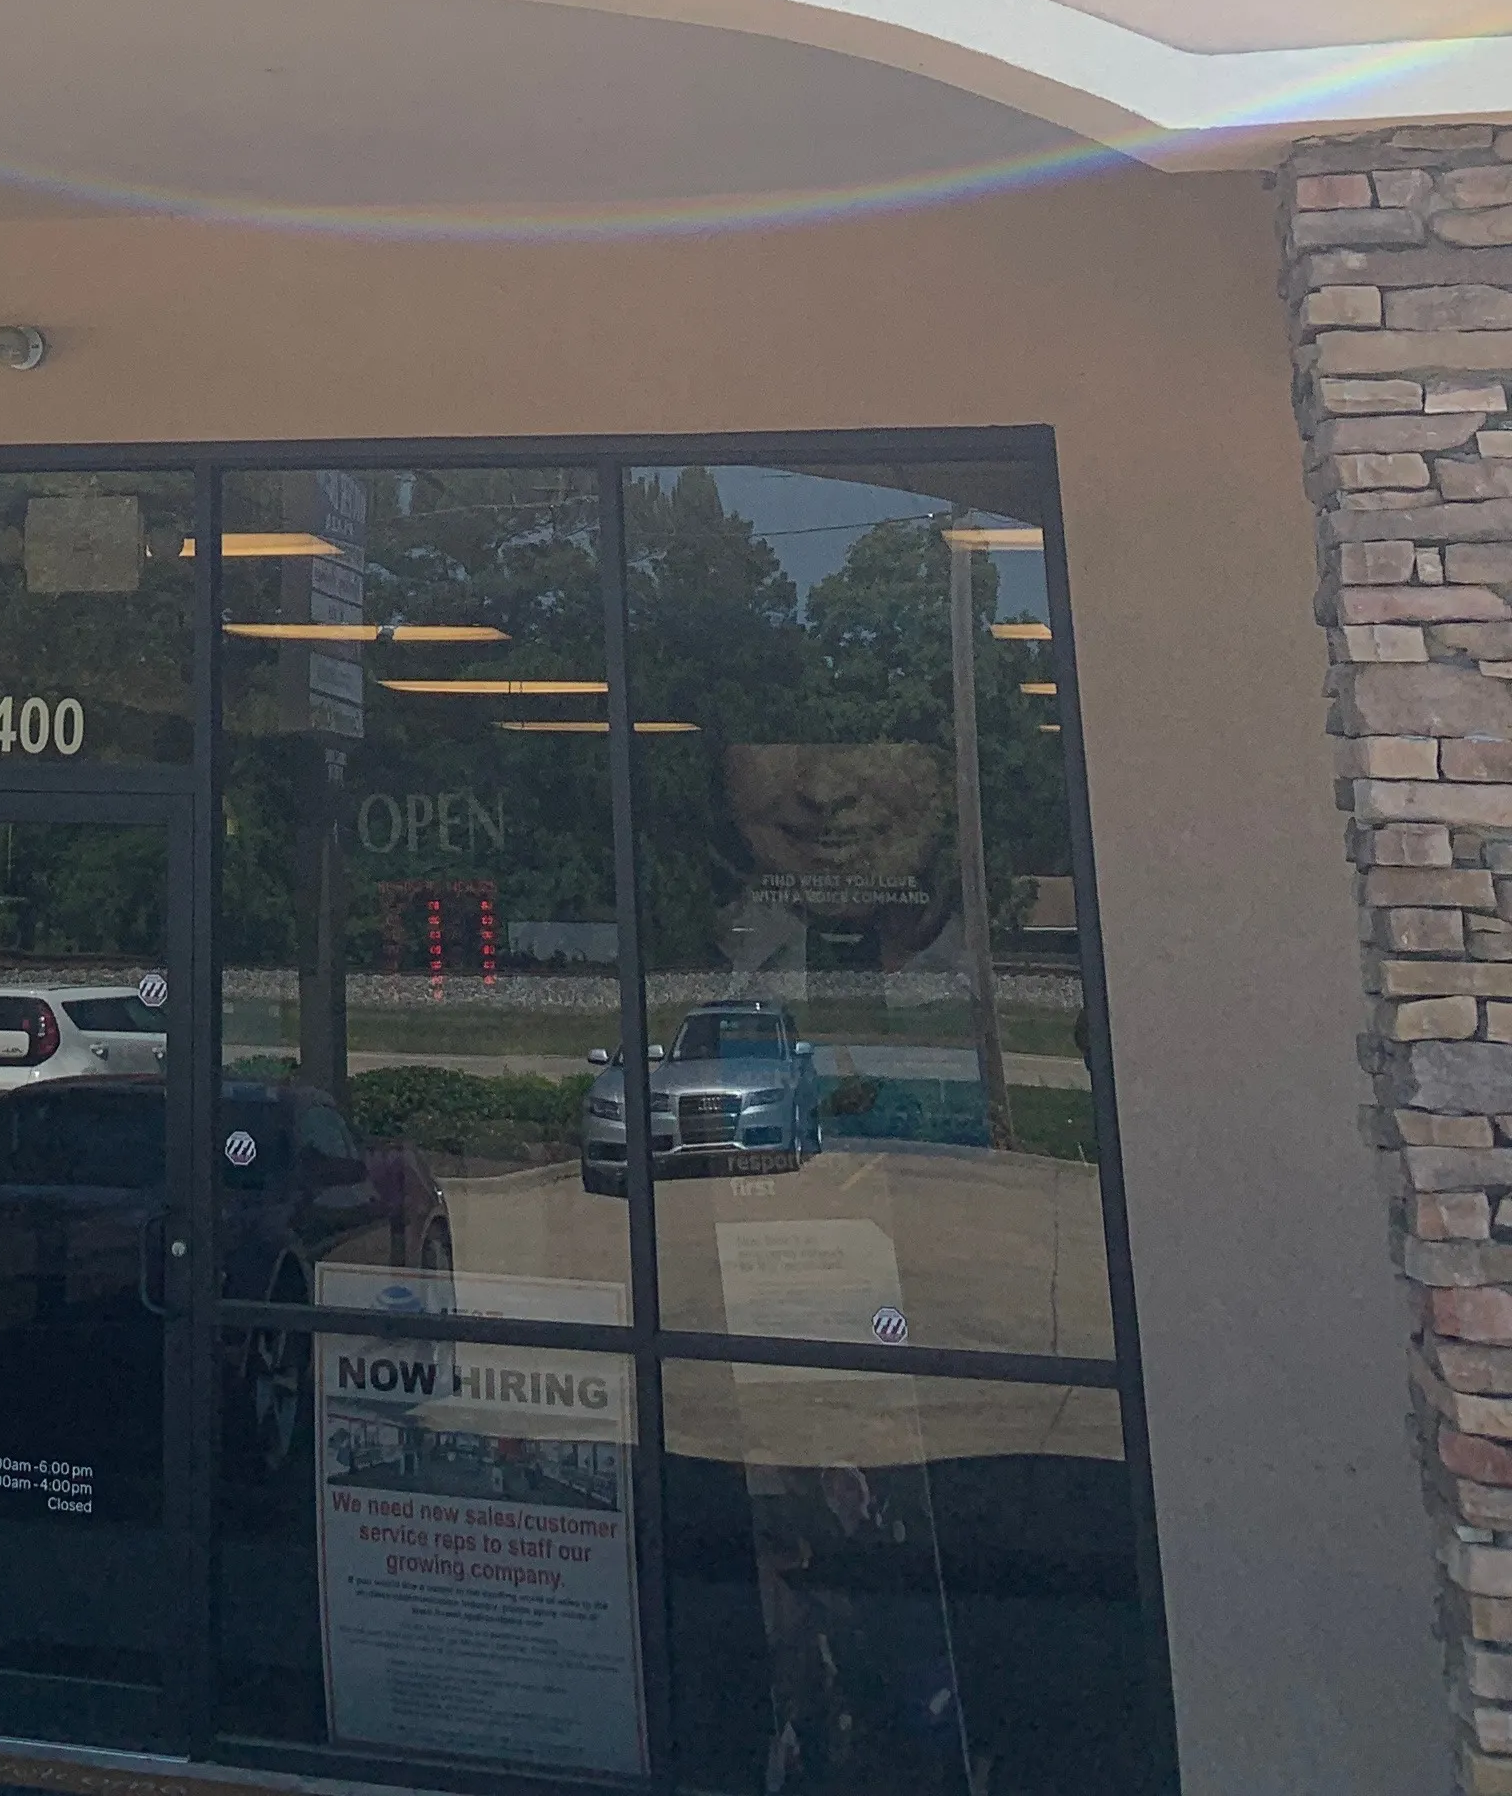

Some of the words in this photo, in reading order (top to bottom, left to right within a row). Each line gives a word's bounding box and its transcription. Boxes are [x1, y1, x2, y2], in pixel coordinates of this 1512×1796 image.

[357, 786, 505, 854] OPEN
[751, 890, 790, 904] WITH
[852, 890, 930, 904] COMMAND
[761, 874, 797, 887] FIND
[801, 874, 840, 888] WHAT
[845, 875, 875, 888] YOU
[878, 875, 918, 889] LOVE
[338, 1355, 437, 1395] NOW
[453, 1364, 609, 1410] HIRING
[47, 1496, 92, 1513] Closed
[332, 1491, 362, 1513] We
[368, 1497, 414, 1520] need
[419, 1504, 459, 1524] new
[464, 1505, 618, 1539] sales/customer
[359, 1523, 428, 1546] service
[434, 1531, 477, 1554] reps
[483, 1533, 502, 1553] to
[508, 1536, 555, 1559] staff
[557, 1544, 592, 1563] our
[385, 1554, 465, 1581] growing
[470, 1560, 566, 1593] company.
